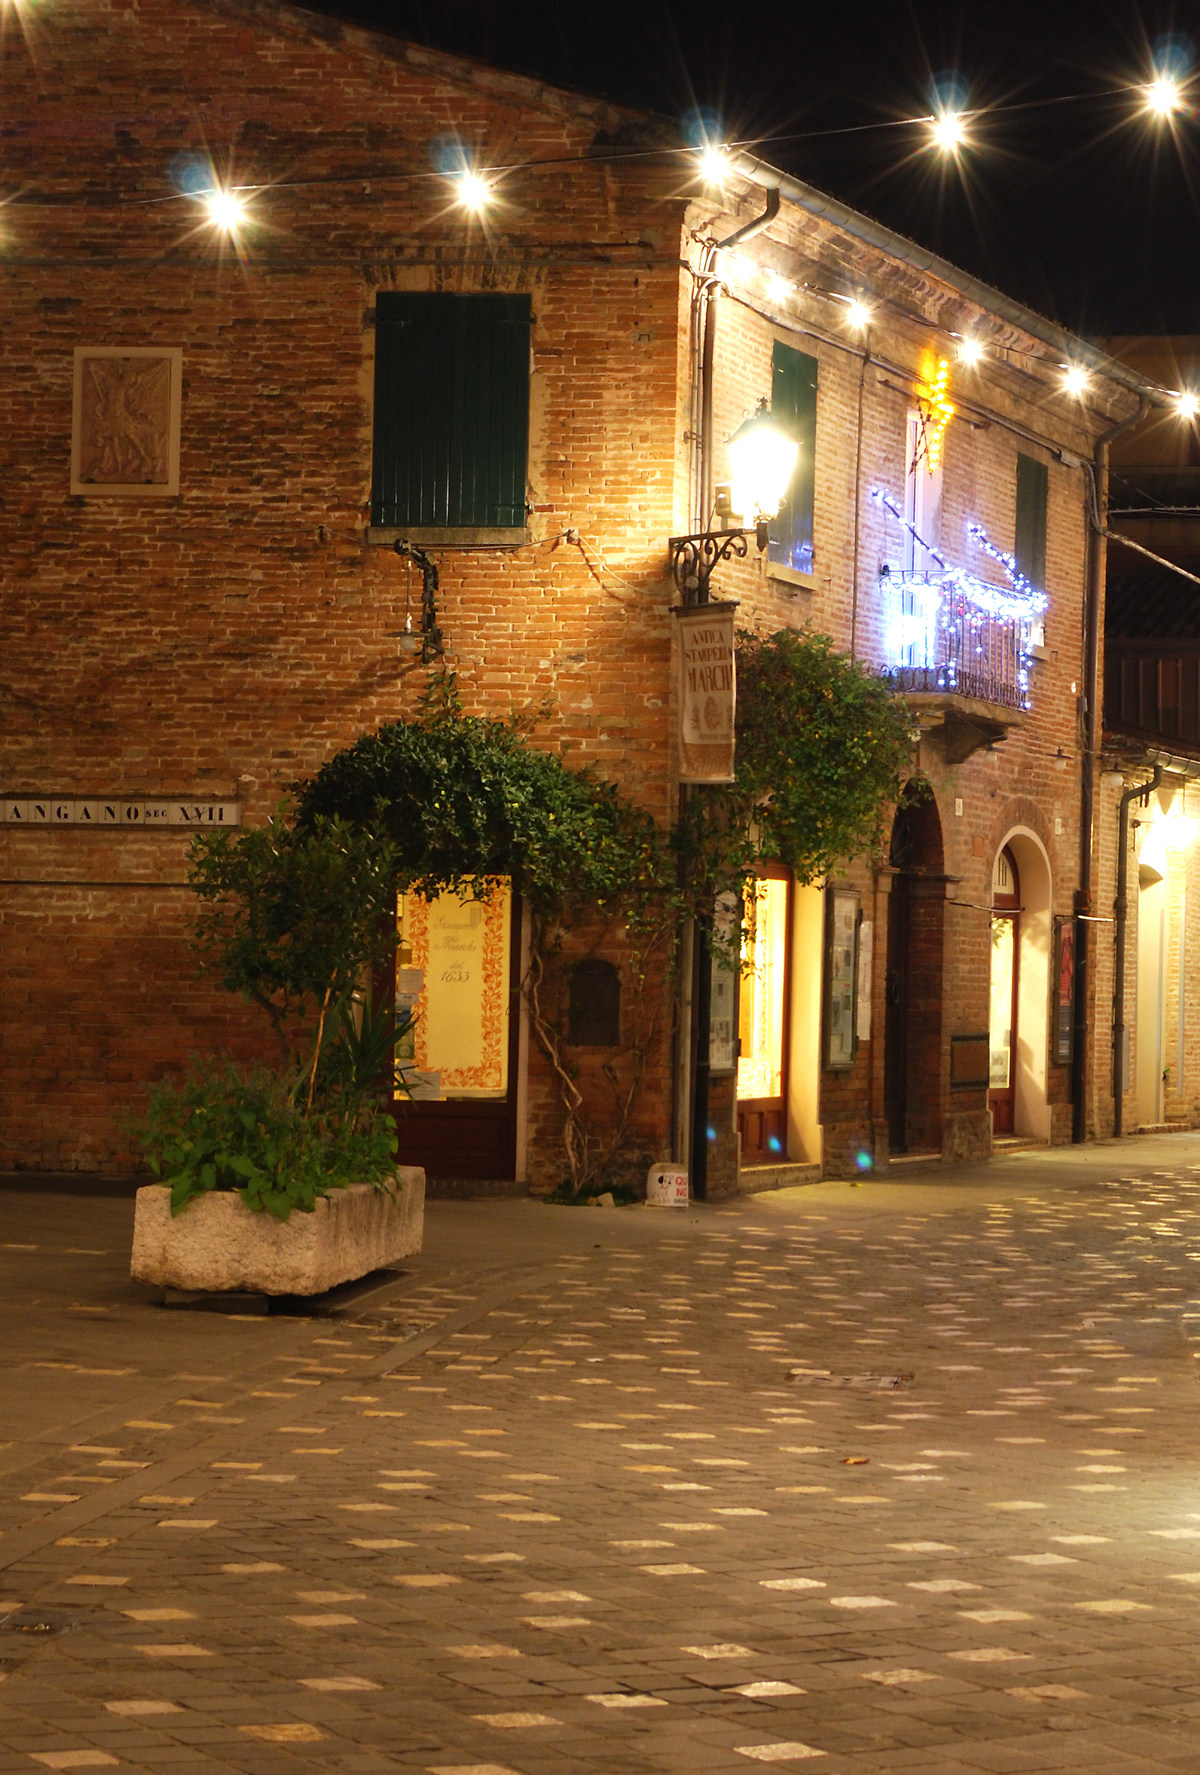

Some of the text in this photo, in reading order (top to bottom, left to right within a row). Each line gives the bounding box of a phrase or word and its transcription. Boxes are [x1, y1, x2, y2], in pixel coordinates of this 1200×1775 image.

[691, 630, 724, 646] ANTICA
[10, 804, 139, 821] ANGANO
[179, 806, 224, 822] XVII
[440, 970, 470, 983] 1633
